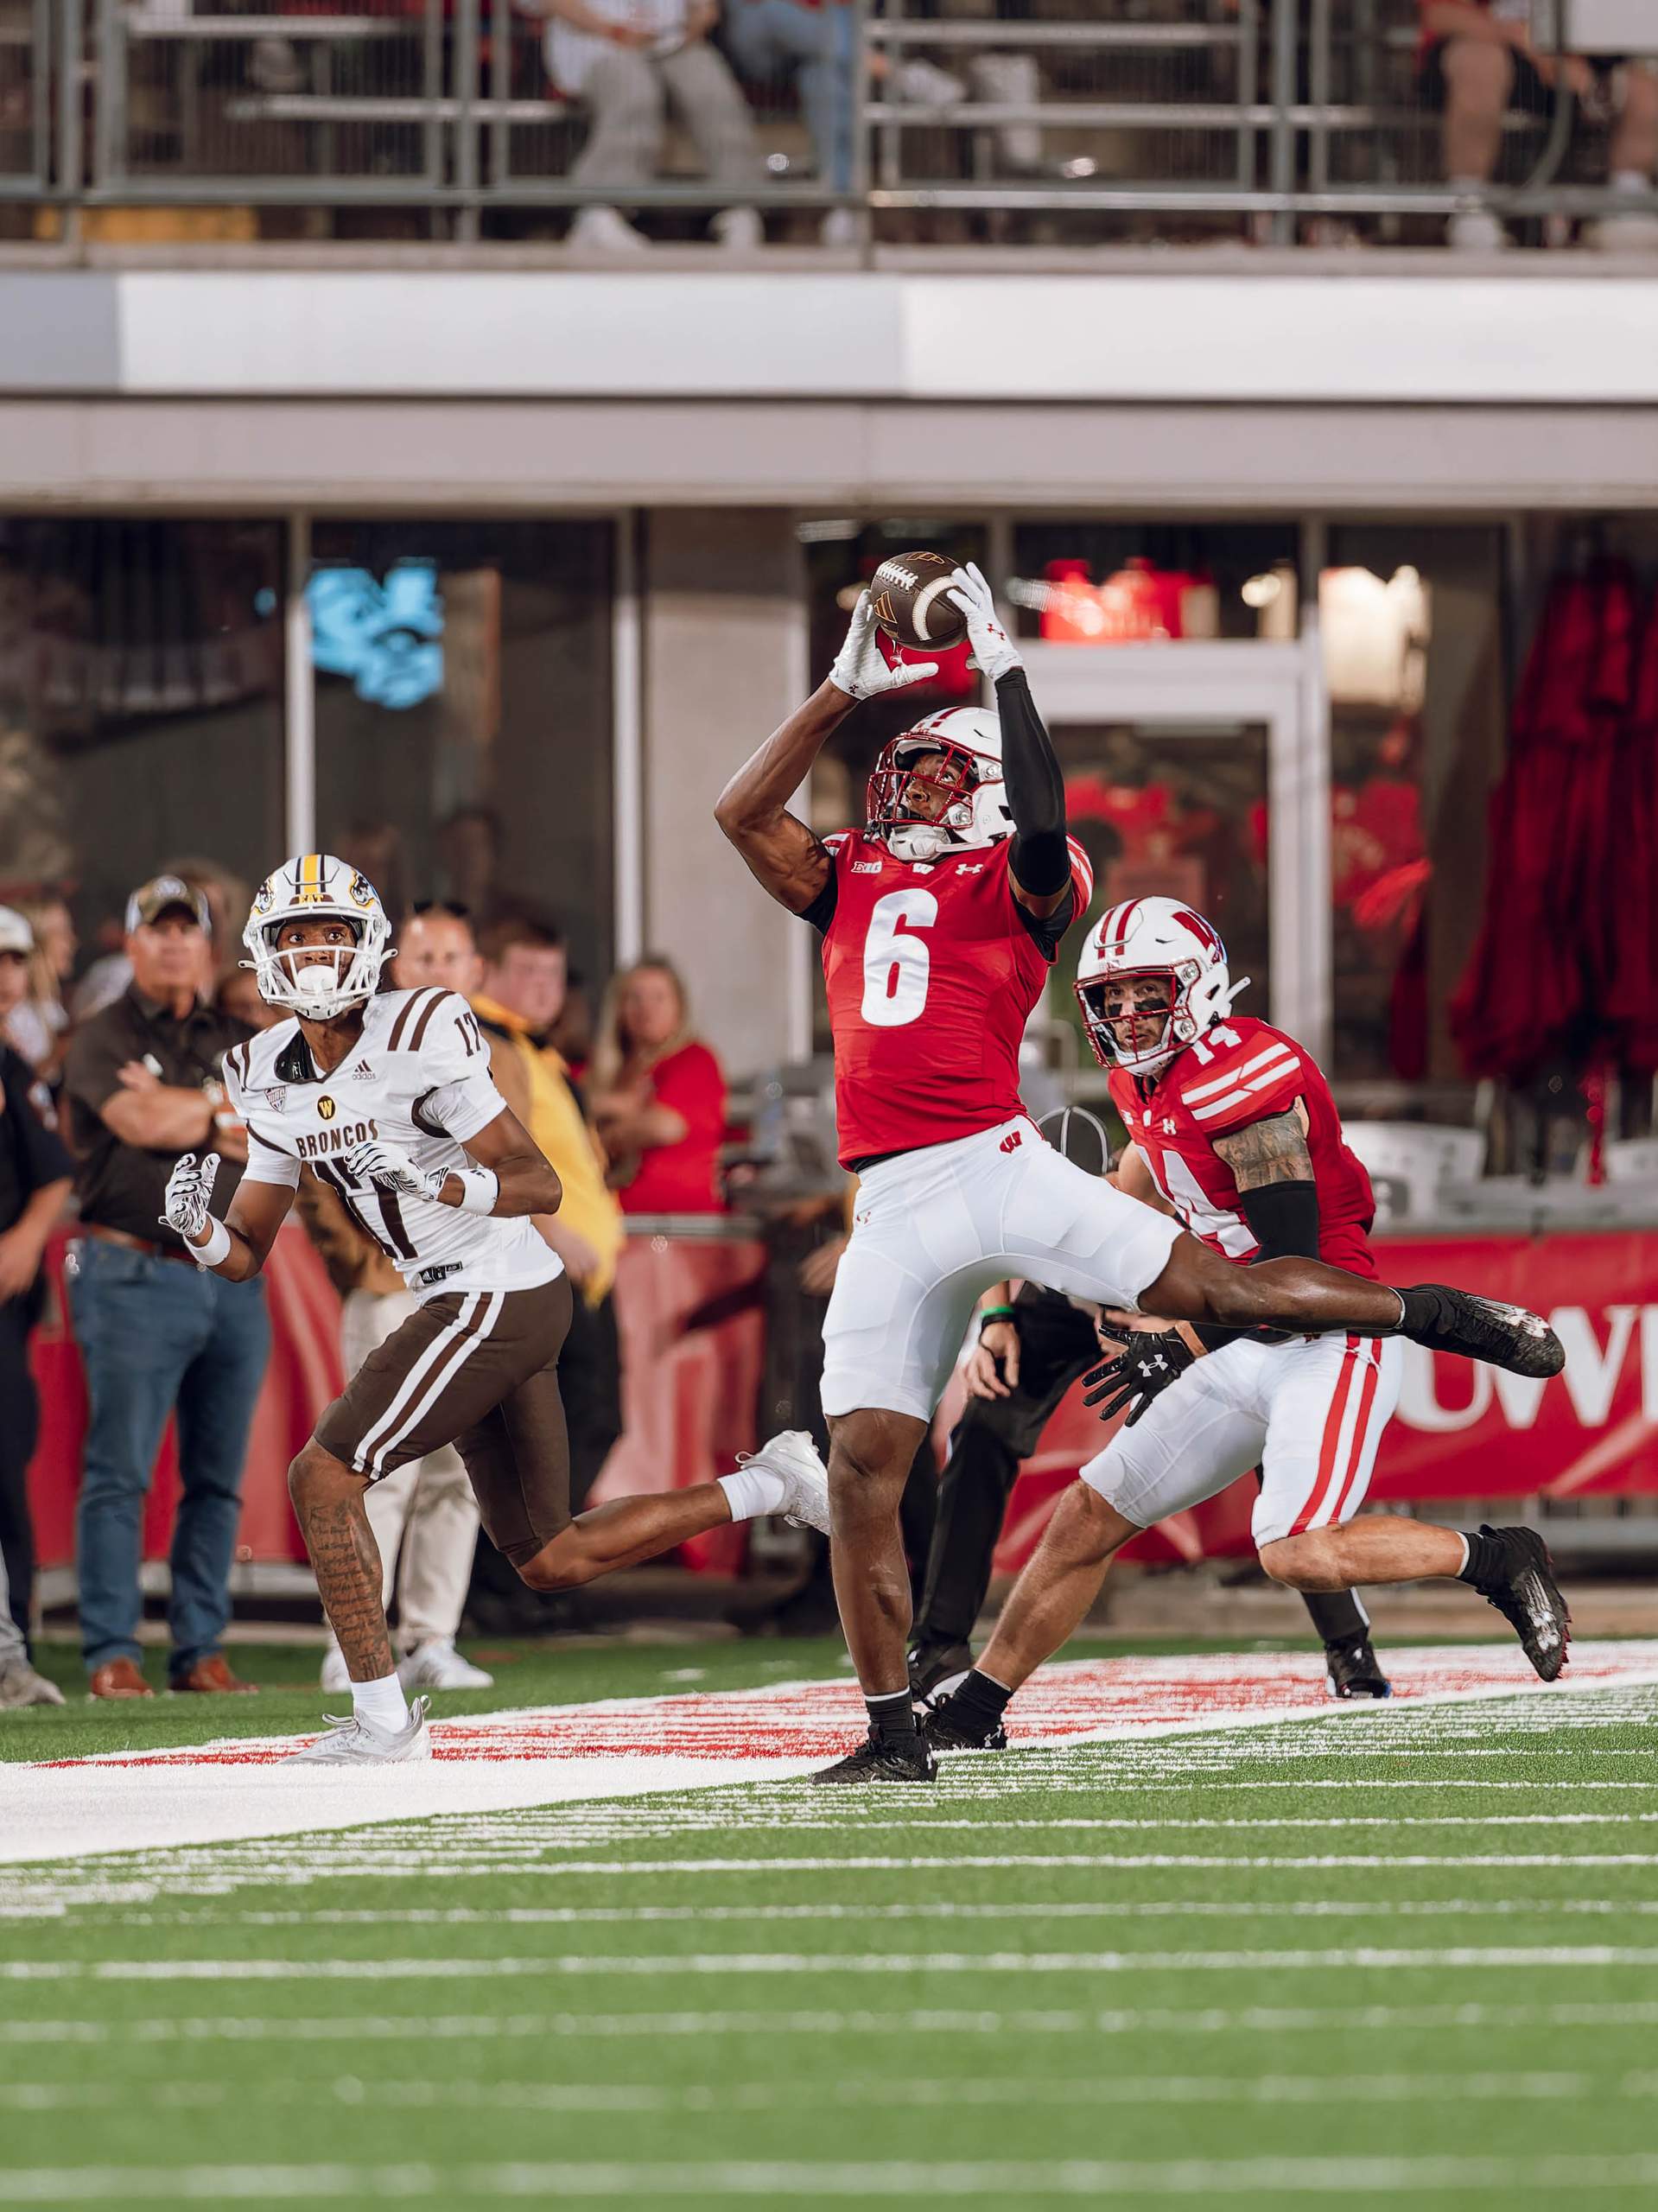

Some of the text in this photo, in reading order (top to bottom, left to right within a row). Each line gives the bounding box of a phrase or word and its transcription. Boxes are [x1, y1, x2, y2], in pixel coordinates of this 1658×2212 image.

[861, 887, 939, 1027] 6
[454, 1012, 481, 1058] 17
[1192, 1025, 1242, 1065] 14
[352, 1071, 377, 1081] adidas
[318, 1099, 334, 1118] W
[295, 1119, 378, 1158] BRONCOS
[314, 1155, 419, 1260] 17
[1393, 1304, 1658, 1433] UW
